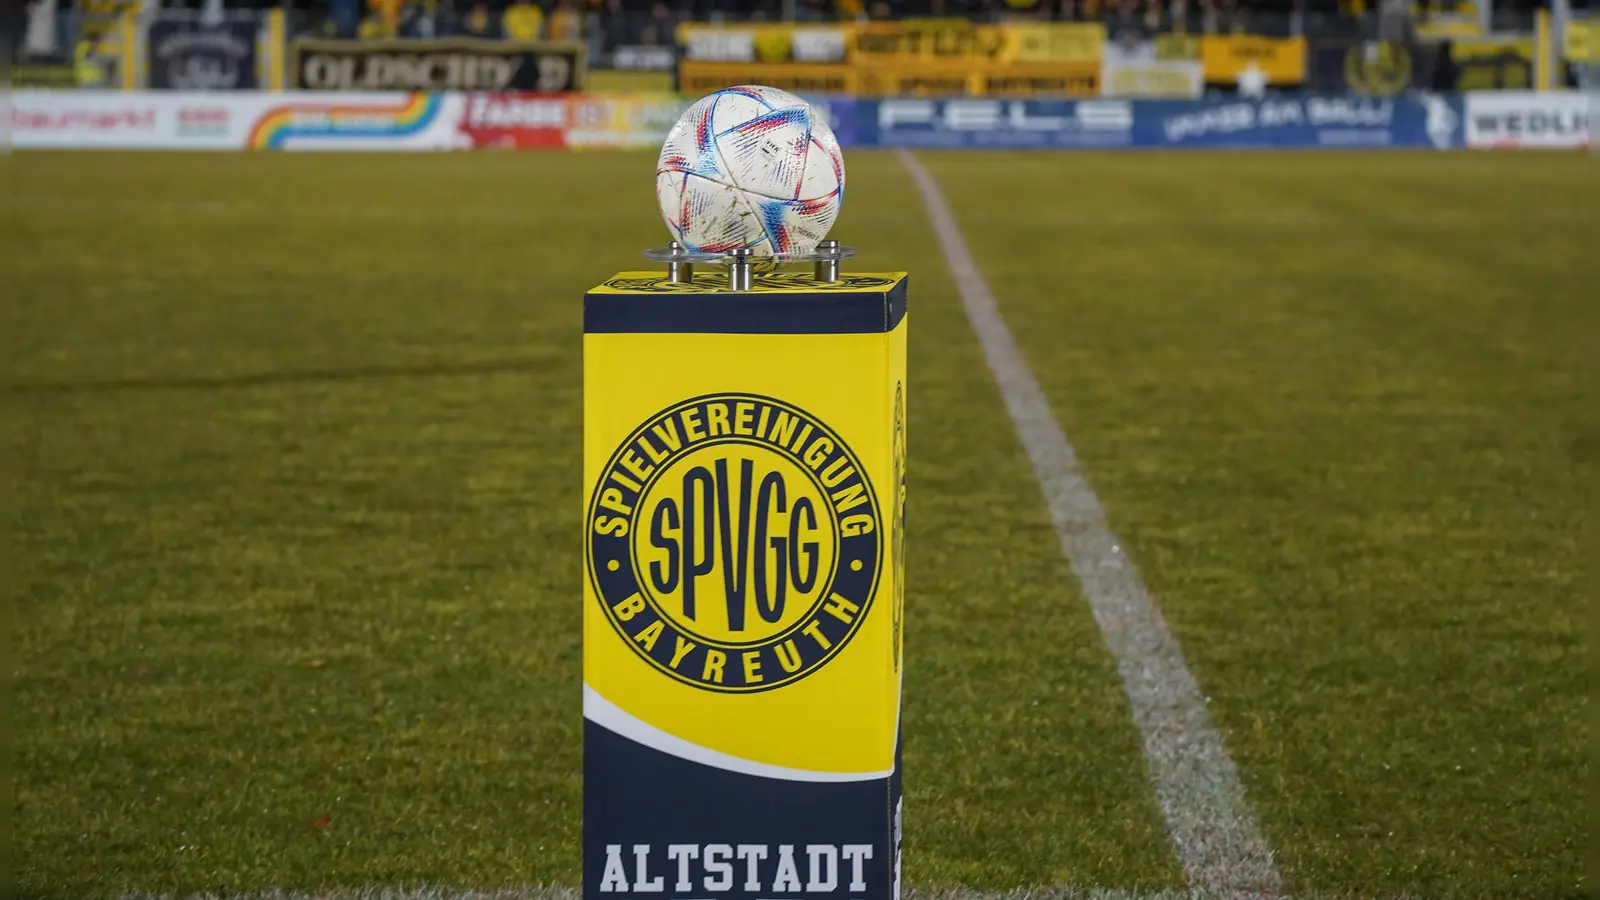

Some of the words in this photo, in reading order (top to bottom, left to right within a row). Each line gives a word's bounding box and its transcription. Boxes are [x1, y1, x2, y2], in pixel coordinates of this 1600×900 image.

[1473, 108, 1588, 134] WEDLI
[594, 402, 875, 538] SPIELVEREINIGUNG
[649, 458, 820, 632] SPVGG
[612, 592, 860, 684] BAYREUTH
[600, 844, 873, 893] ALTSTADT
